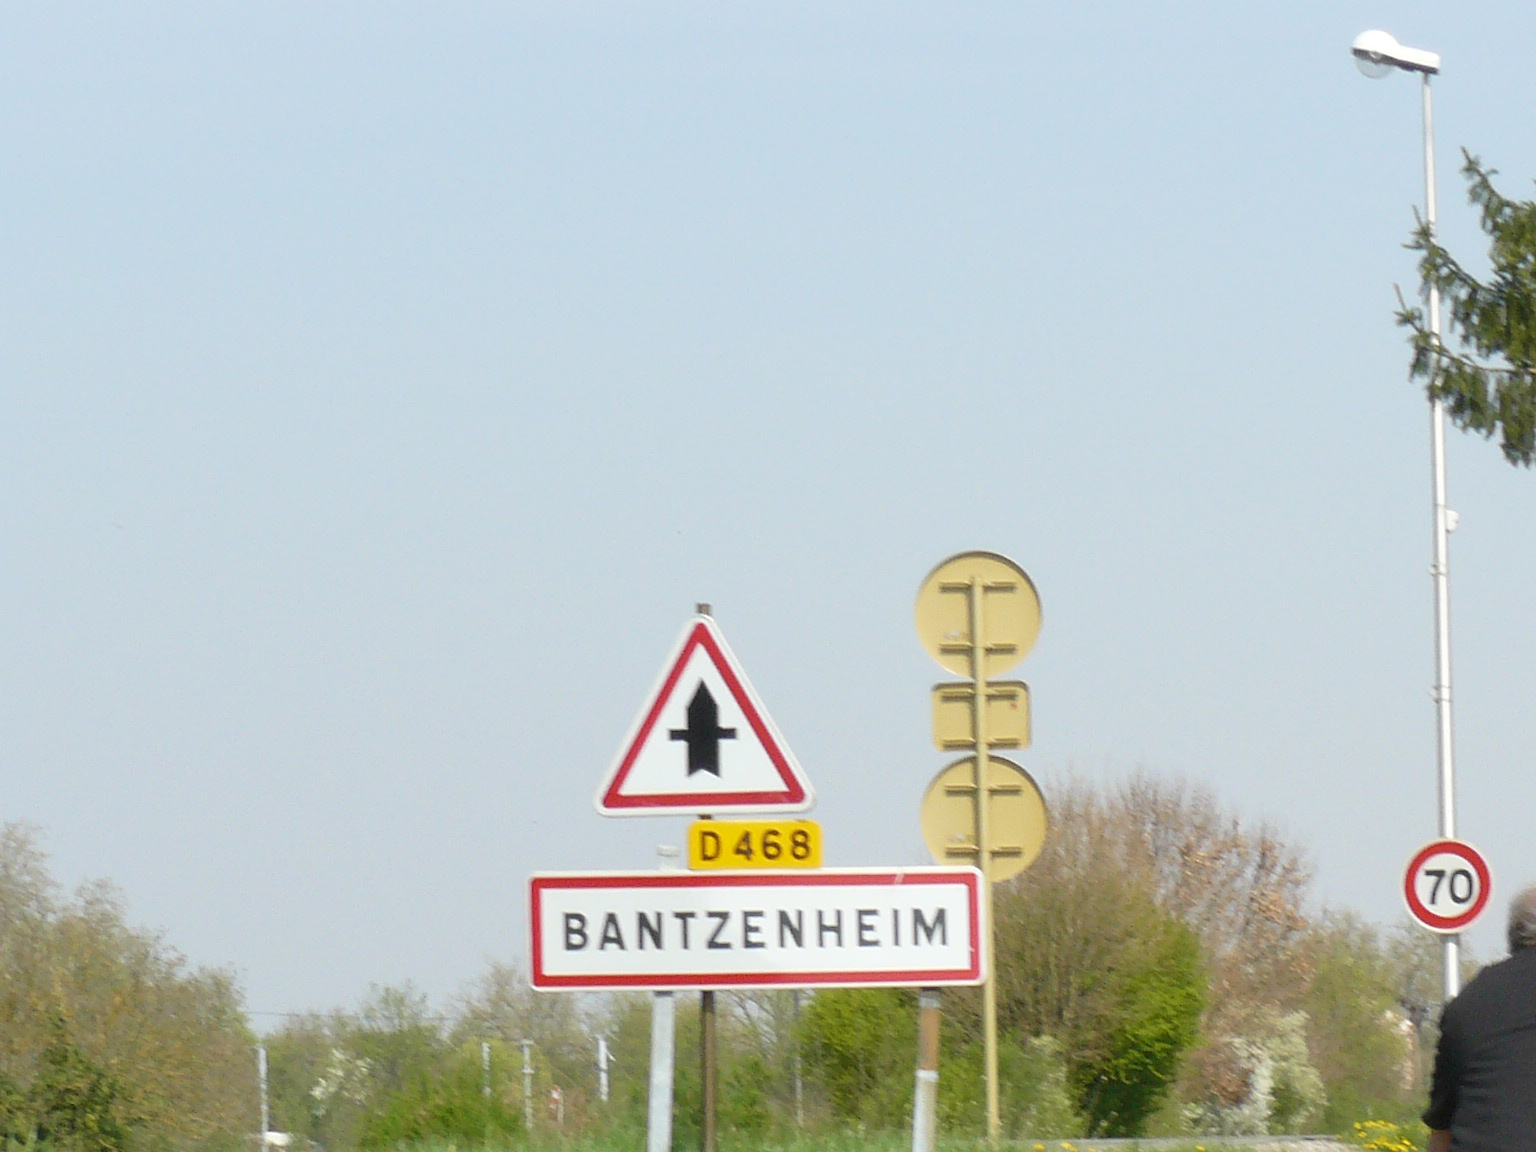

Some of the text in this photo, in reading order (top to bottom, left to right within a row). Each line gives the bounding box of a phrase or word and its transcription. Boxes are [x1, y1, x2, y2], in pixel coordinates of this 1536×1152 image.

[733, 830, 812, 861] 468
[1424, 869, 1473, 905] 70
[563, 907, 948, 951] BANTZENHEIM
